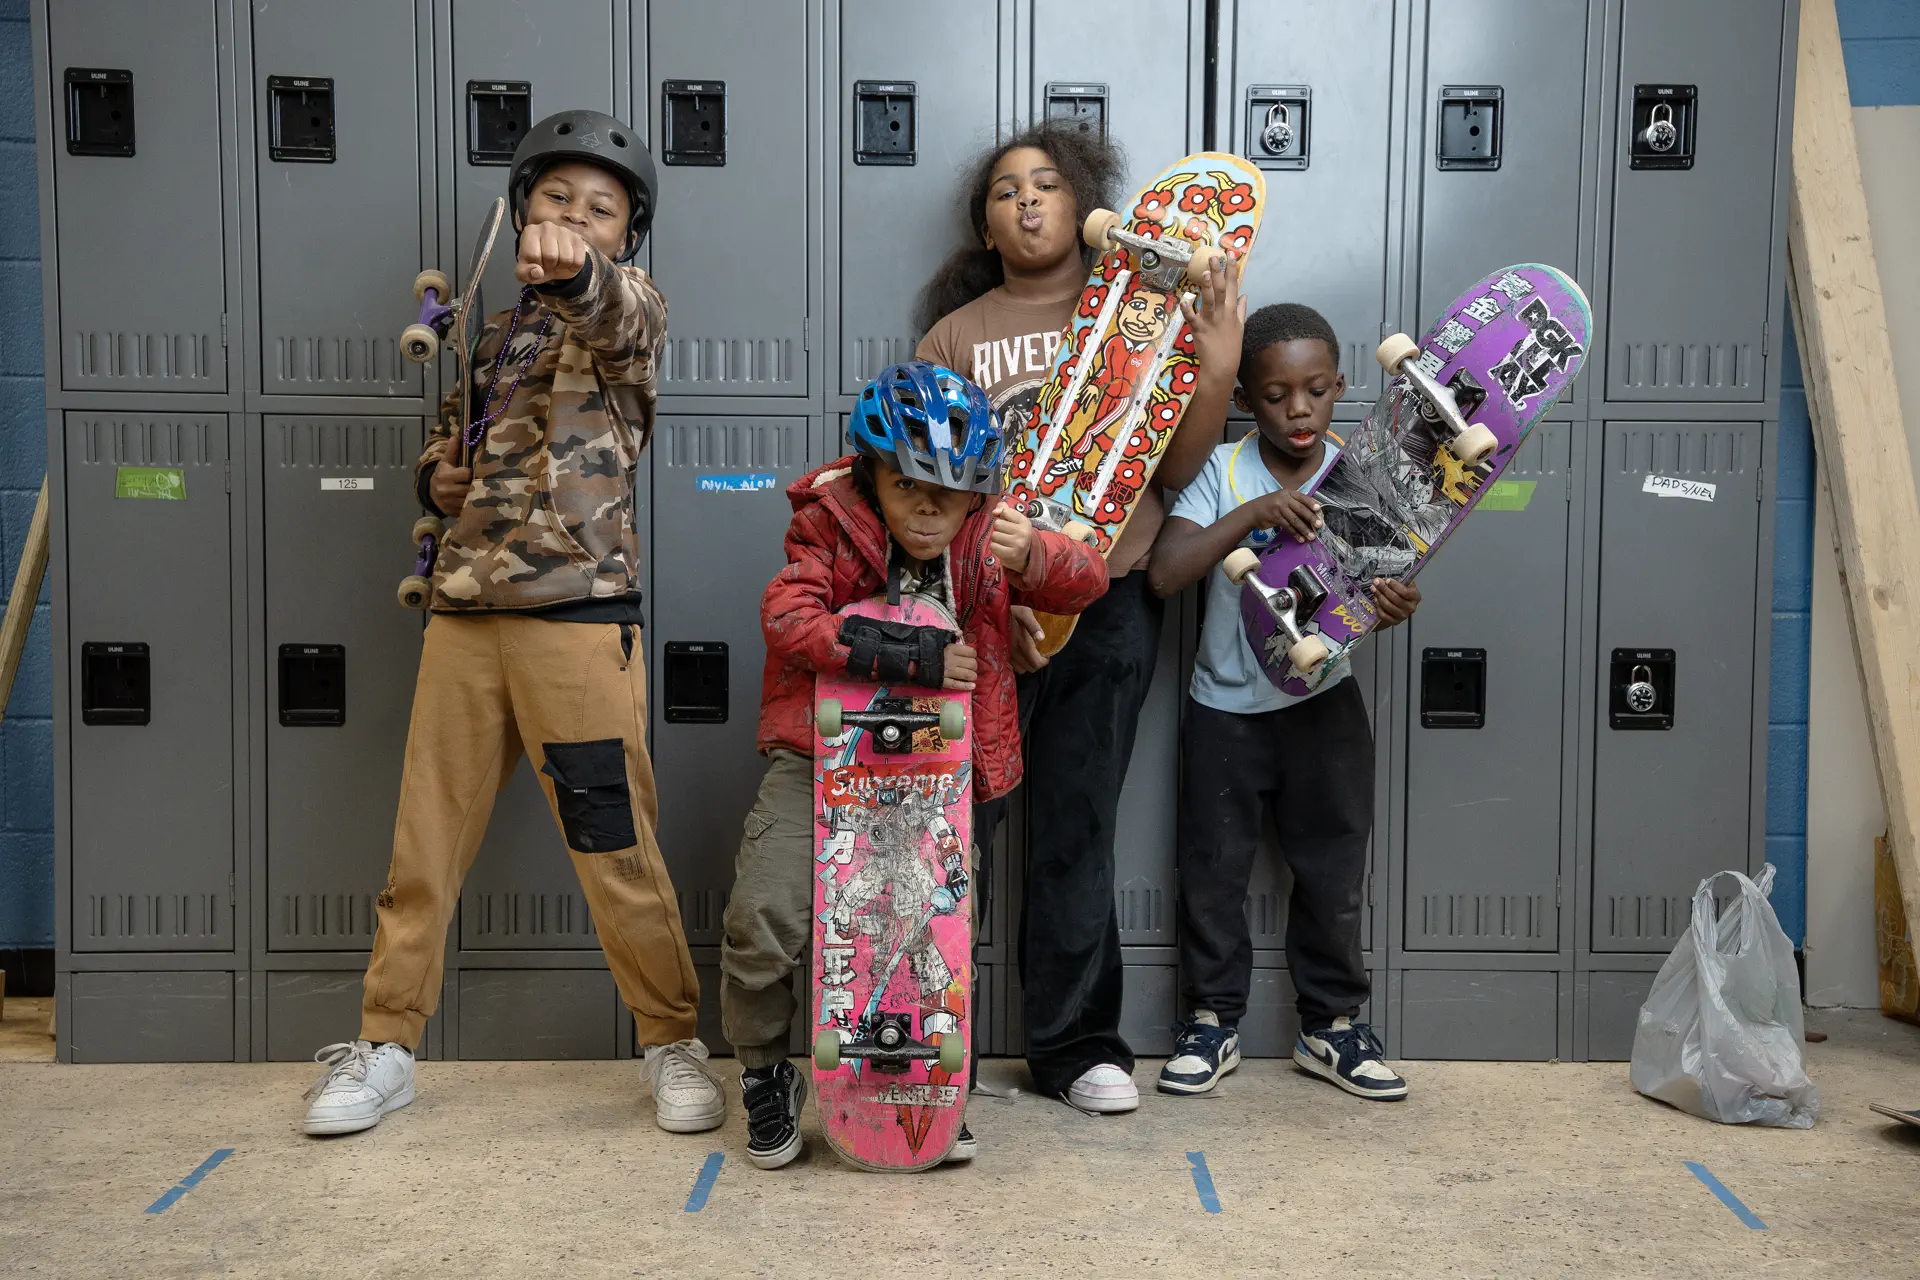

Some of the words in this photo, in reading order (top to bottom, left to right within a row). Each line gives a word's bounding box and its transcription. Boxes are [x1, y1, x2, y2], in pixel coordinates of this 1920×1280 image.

[1517, 296, 1583, 373] DGK
[973, 331, 1063, 390] RIVER
[339, 479, 357, 489] 125
[1075, 470, 1134, 504] KRKED
[831, 769, 955, 801] Supreme
